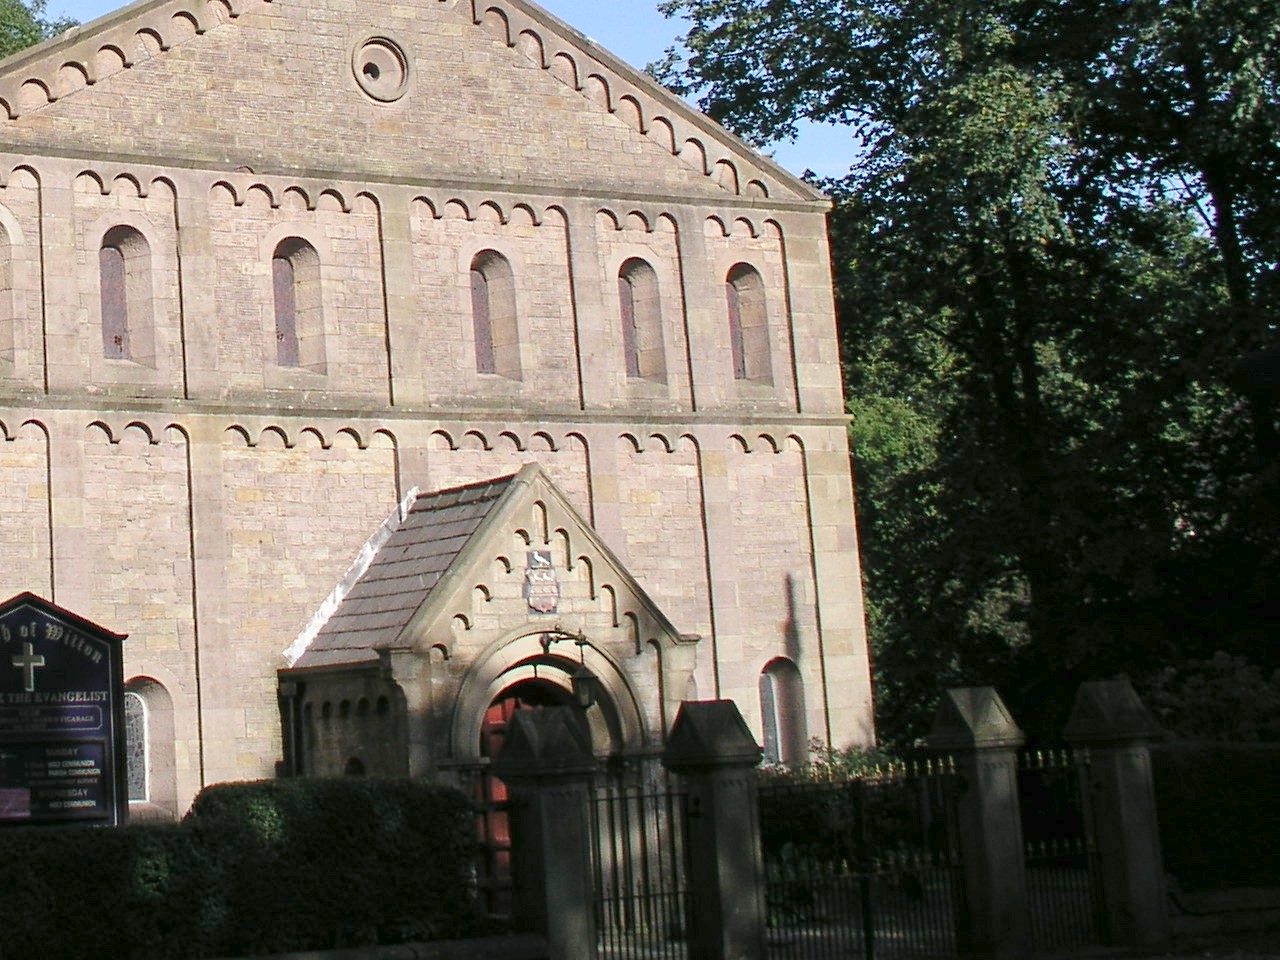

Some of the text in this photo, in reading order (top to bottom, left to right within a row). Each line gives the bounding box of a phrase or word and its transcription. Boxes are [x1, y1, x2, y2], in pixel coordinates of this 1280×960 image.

[19, 621, 37, 638] of
[7, 692, 32, 703] THE
[34, 690, 108, 702] EVANGELIST
